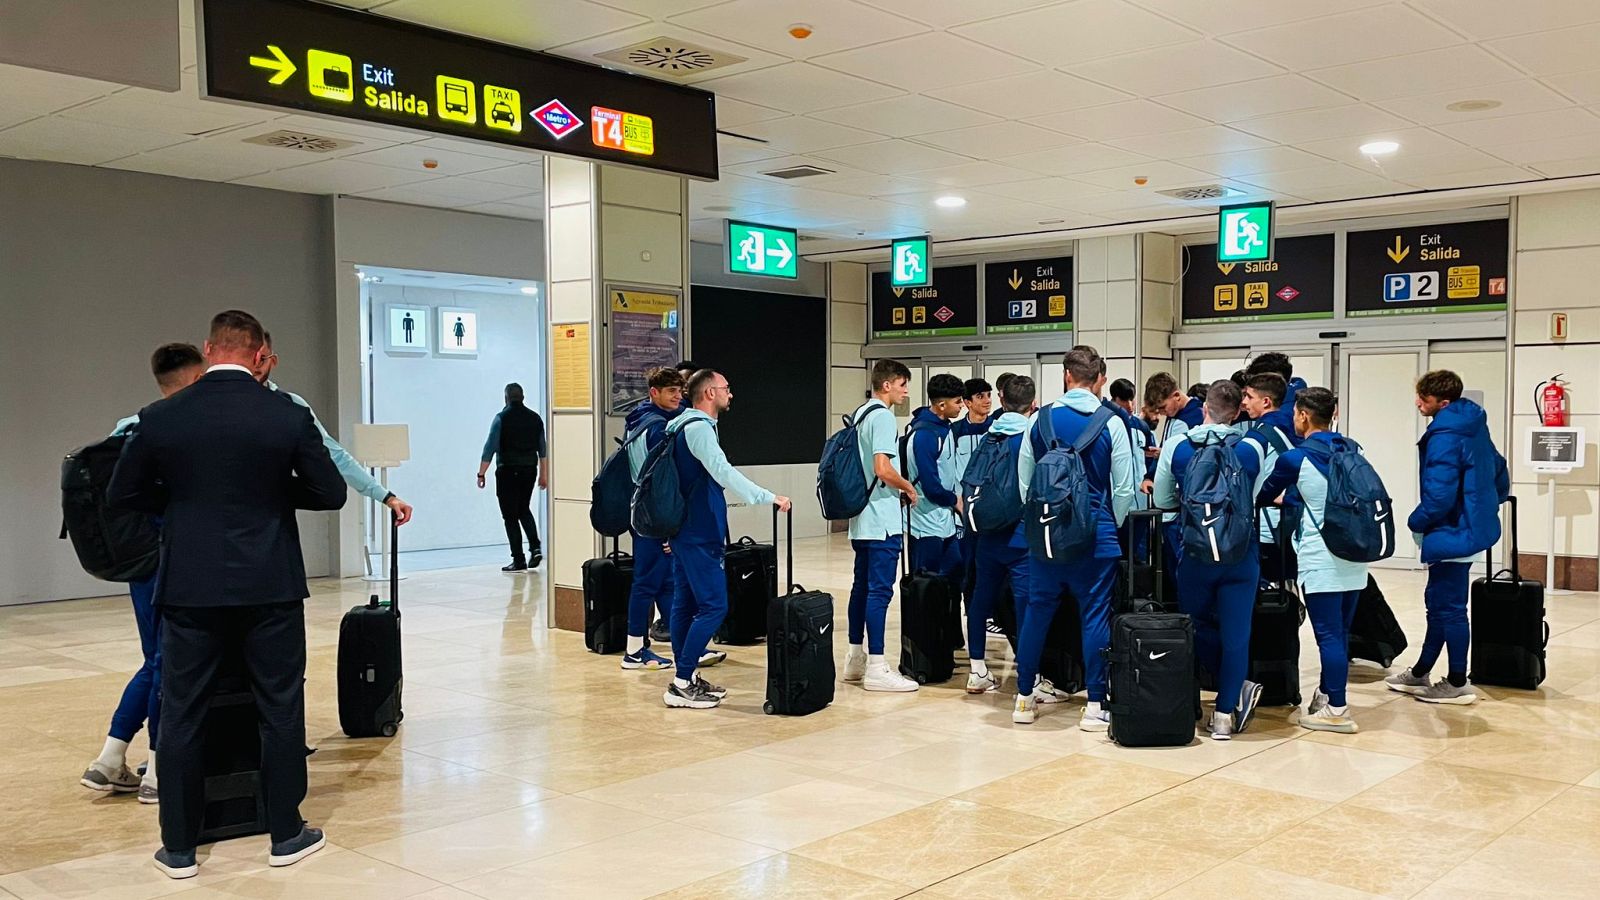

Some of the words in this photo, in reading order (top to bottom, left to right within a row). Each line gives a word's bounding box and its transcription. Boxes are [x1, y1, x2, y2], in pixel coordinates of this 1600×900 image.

[363, 63, 394, 86] Exit
[491, 89, 513, 100] TAXI
[364, 86, 429, 116] Salida
[546, 112, 568, 124] Metro
[594, 109, 621, 121] Terminal
[593, 117, 622, 146] T4
[624, 125, 638, 139] BUS
[1420, 233, 1441, 246] Exit
[1420, 247, 1460, 261] Salida
[1036, 266, 1053, 277] Exit
[1244, 261, 1279, 273] Salida
[1030, 279, 1060, 291] Salida
[1390, 276, 1406, 299] P
[1417, 275, 1432, 297] 2
[1448, 277, 1463, 289] BUS
[1490, 282, 1505, 294] T4
[911, 287, 938, 299] Salida
[1012, 303, 1020, 316] P
[1025, 302, 1033, 316] 2
